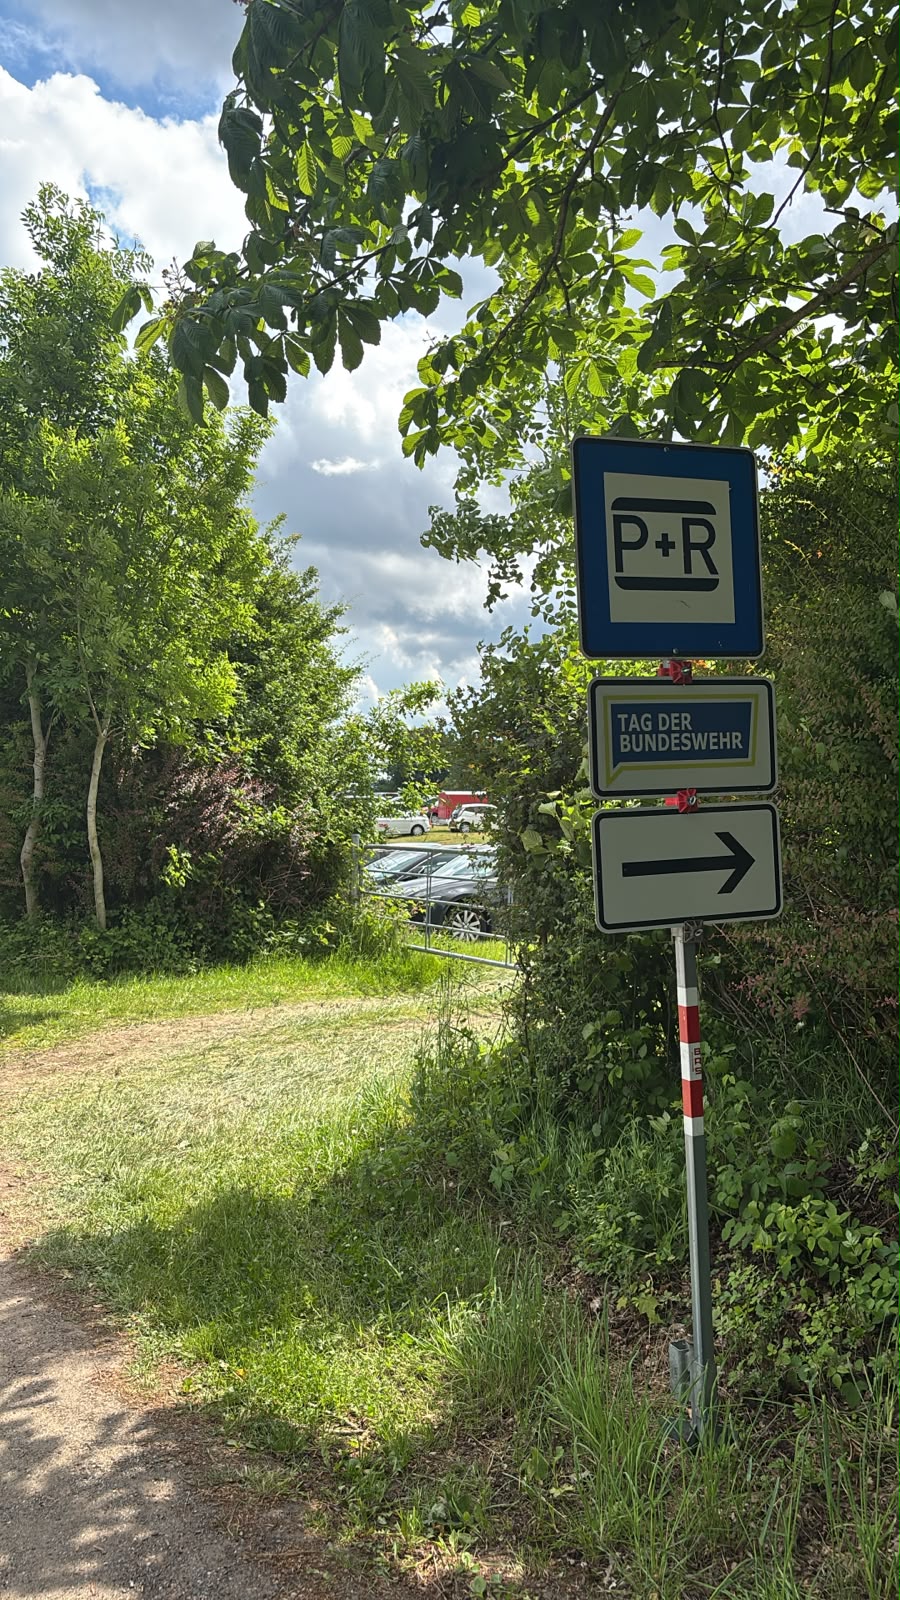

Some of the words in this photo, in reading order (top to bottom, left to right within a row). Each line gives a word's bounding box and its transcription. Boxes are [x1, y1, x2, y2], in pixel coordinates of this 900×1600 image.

[612, 514, 719, 575] P+R
[617, 713, 652, 732] TAG
[658, 712, 692, 731] DER
[620, 731, 743, 753] BUNDESWEHR
